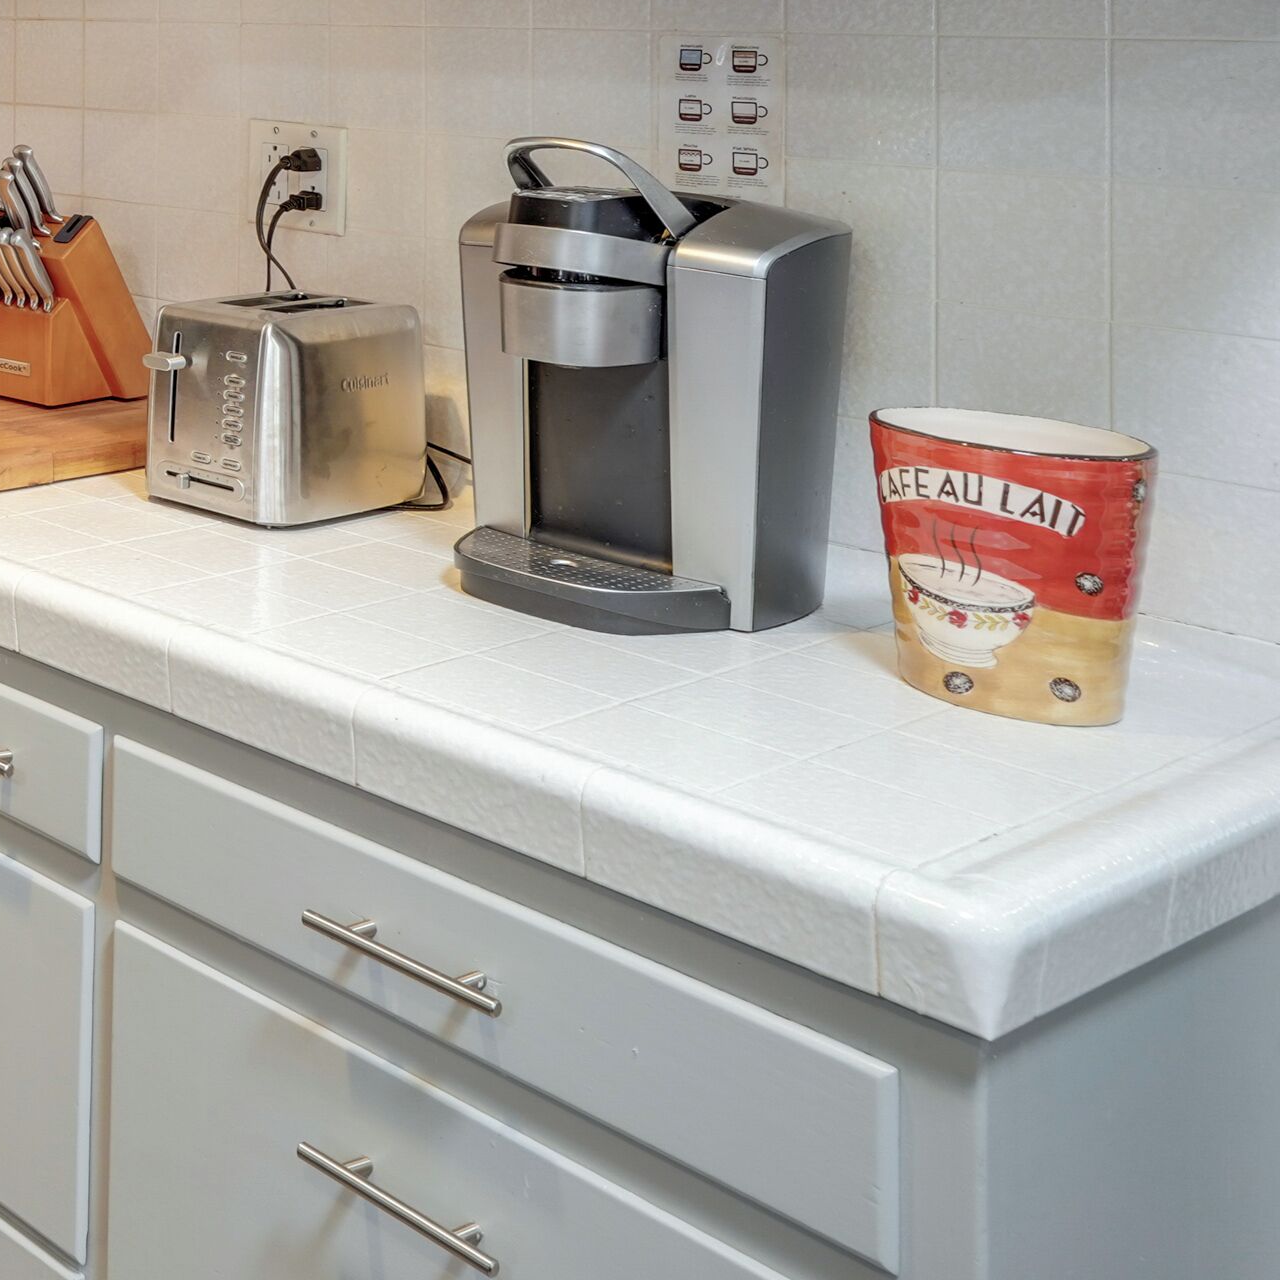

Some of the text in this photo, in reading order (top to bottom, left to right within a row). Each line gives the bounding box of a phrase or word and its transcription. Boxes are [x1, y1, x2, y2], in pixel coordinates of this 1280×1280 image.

[880, 467, 1086, 537] CAFE AU LAIT
